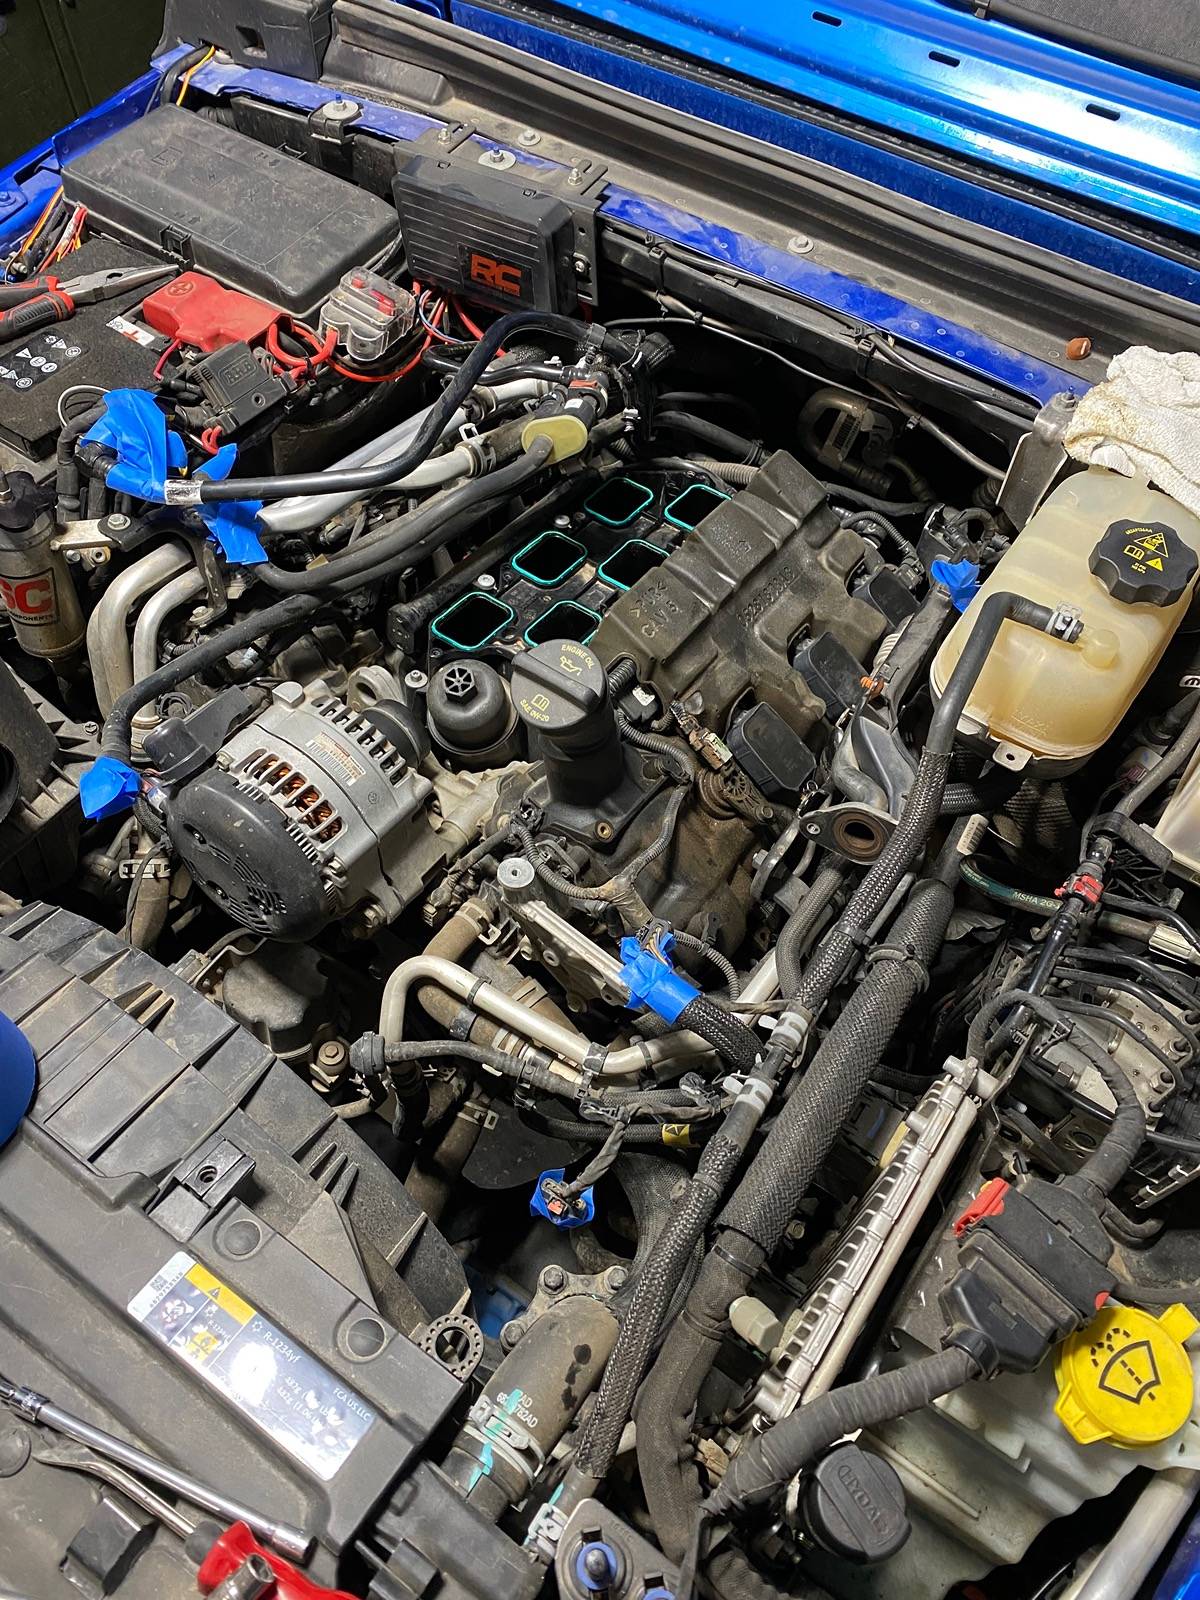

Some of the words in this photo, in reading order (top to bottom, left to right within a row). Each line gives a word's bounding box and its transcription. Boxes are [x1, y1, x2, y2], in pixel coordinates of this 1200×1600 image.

[471, 253, 521, 296] RC
[561, 644, 587, 660] ENGINE
[585, 655, 595, 669] OIL
[520, 699, 533, 713] SAE
[1012, 891, 1038, 905] MSHA
[263, 1331, 302, 1364] R-1234yf
[333, 1387, 348, 1402] FCA
[347, 1398, 359, 1411] US
[357, 1407, 372, 1421] LLC
